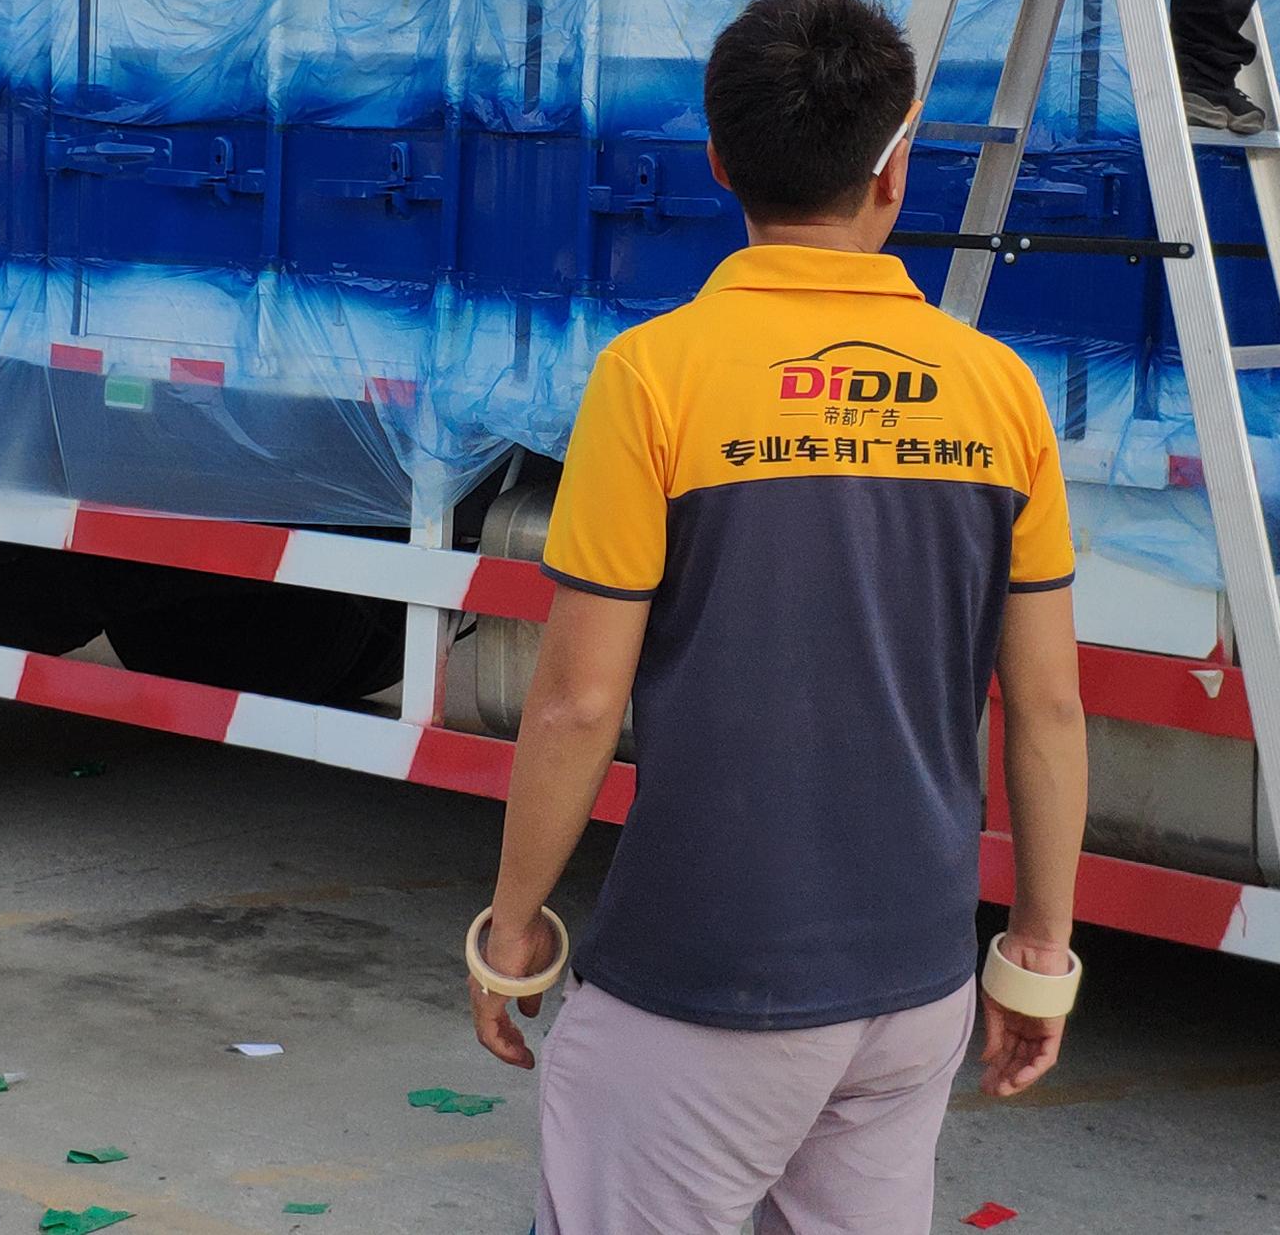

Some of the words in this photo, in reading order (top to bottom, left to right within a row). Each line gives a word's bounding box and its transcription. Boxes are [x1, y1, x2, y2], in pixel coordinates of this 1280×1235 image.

[824, 406, 901, 428] 帝都广告
[721, 435, 994, 469] 专业车身广告制作
